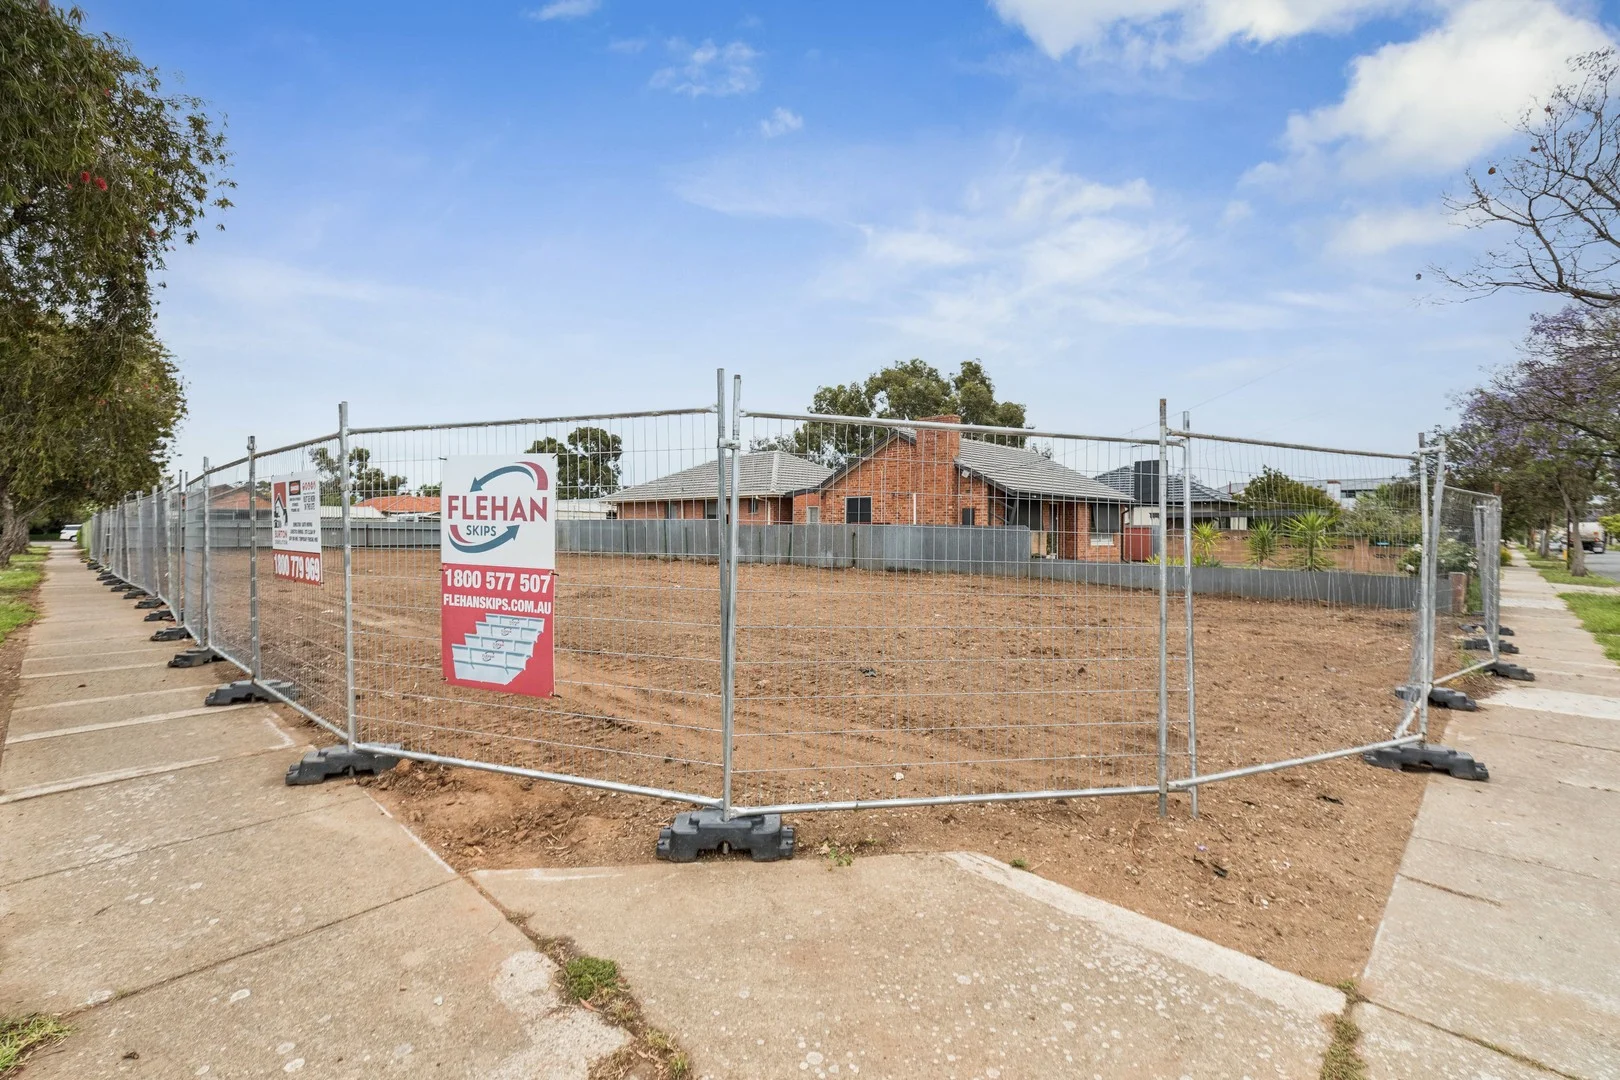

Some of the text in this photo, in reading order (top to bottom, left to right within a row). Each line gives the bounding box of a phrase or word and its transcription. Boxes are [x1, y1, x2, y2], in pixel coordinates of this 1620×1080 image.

[448, 495, 547, 522] FLEHAN
[466, 525, 497, 536] SKIPS
[274, 553, 320, 582] 1800 779 969
[445, 568, 551, 594] 1800 577 507
[443, 593, 552, 614] FLEHANSKIPS.COM.AU
